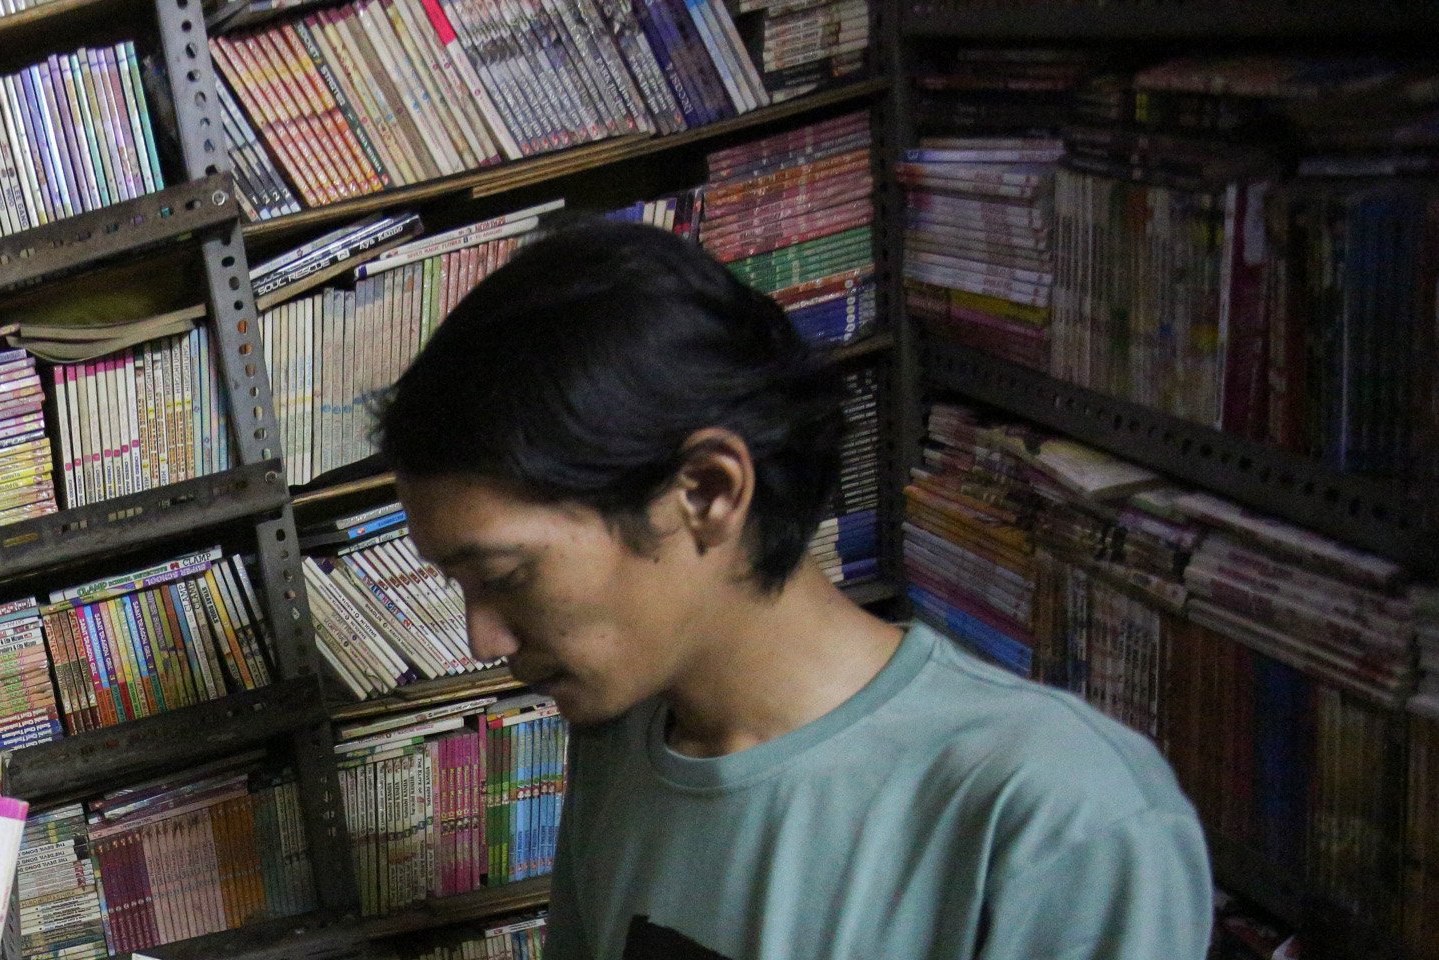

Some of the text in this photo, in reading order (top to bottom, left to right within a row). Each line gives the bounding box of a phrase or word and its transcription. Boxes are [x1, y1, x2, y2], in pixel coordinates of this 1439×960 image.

[319, 64, 347, 107] STARTER
[16, 202, 29, 228] GANG
[286, 257, 330, 282] RESCUE
[181, 551, 212, 567] CLAMP
[144, 570, 178, 585] SCHOOL
[177, 583, 192, 613] CLAMP
[98, 630, 110, 656] DRAGON
[136, 618, 148, 644] DRAGON
[82, 635, 95, 661] DRAGON
[21, 856, 37, 864] DOING
